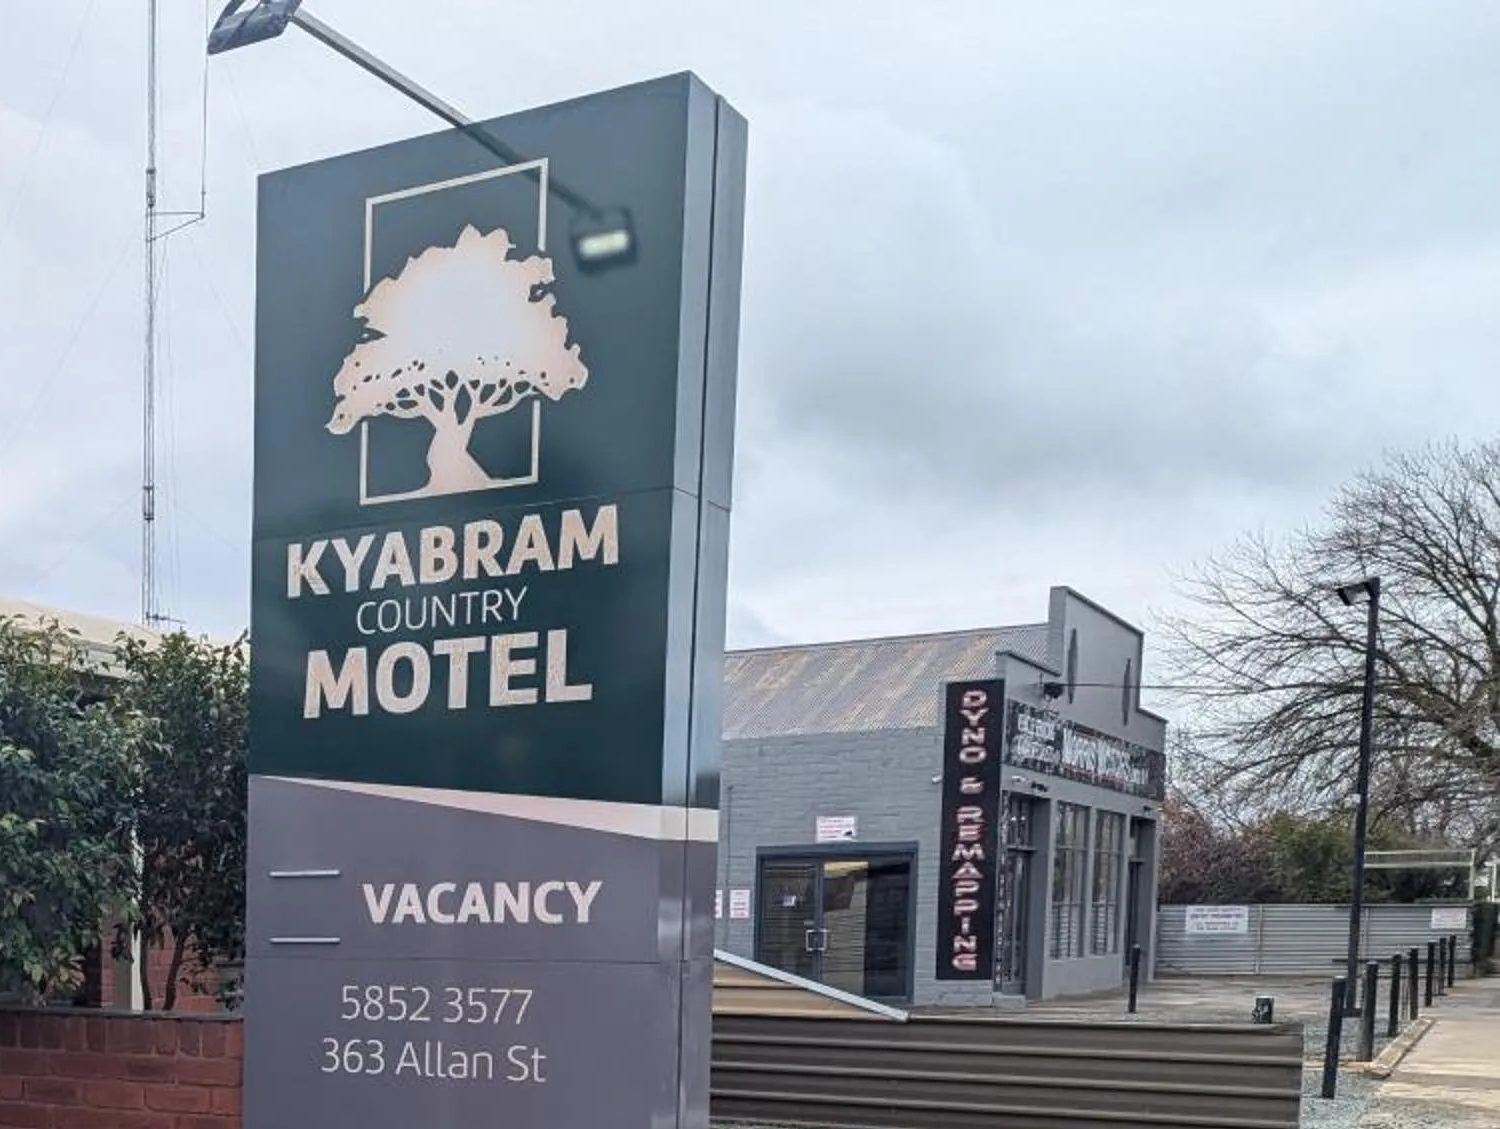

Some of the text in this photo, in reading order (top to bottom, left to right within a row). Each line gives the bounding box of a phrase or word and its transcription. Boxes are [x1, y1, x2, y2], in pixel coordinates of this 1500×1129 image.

[286, 504, 620, 599] KYABRAM
[356, 586, 529, 635] COUNTRY
[303, 628, 594, 720] MOTEL
[959, 689, 989, 764] DYNO
[362, 880, 604, 925] VACANCY
[951, 805, 986, 972] REMAPPING
[340, 984, 534, 1025] 5852 3577
[320, 1037, 548, 1083] 363 Allan St
